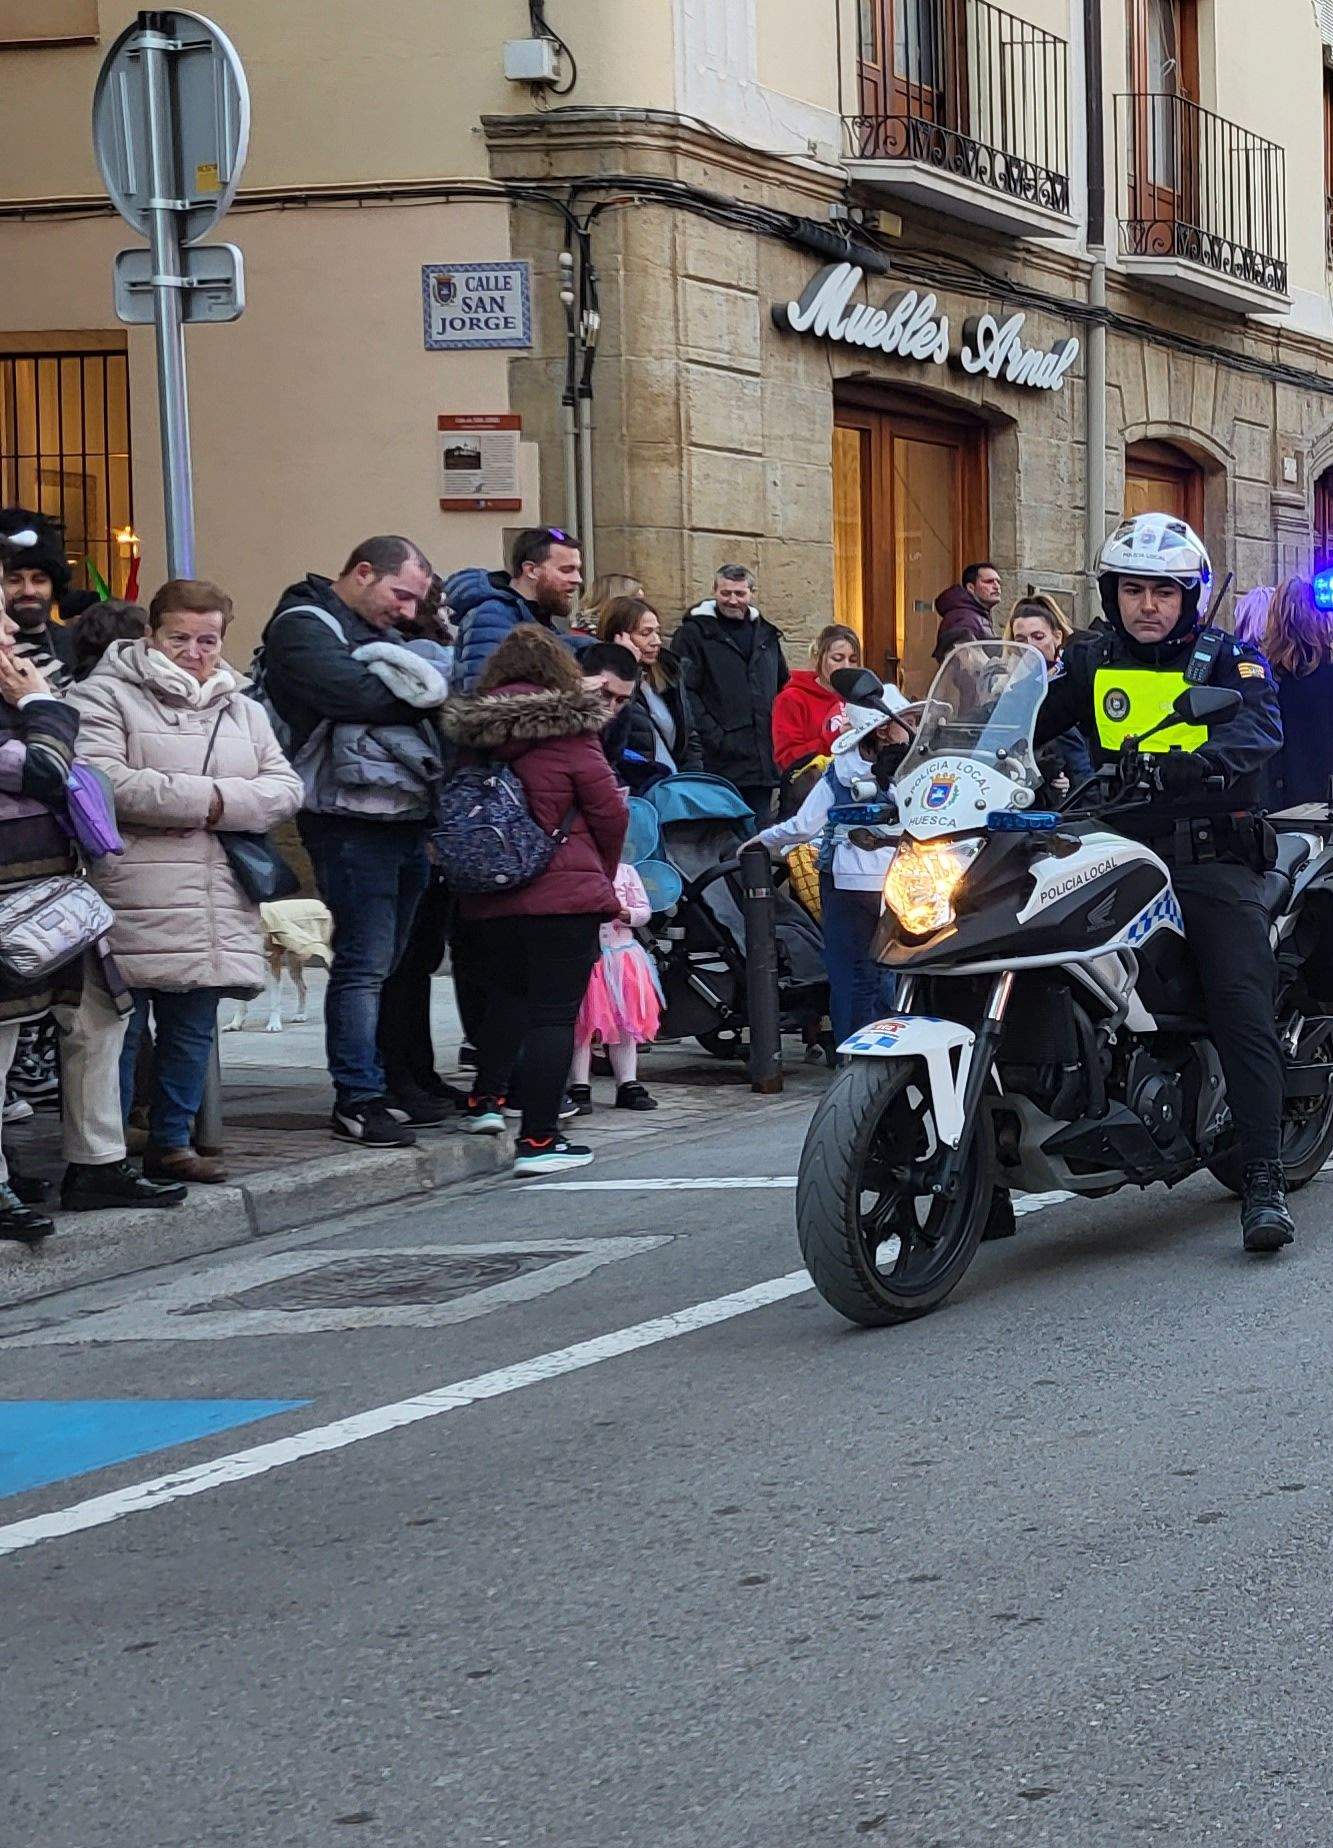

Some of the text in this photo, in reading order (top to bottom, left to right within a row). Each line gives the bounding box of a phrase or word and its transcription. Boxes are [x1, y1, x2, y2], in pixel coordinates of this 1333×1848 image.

[465, 275, 512, 292] CALLE
[461, 295, 506, 314] SAN
[436, 316, 517, 336] JORGE
[786, 262, 1079, 391] Muebles Arnal
[910, 760, 991, 796] POLICIA LOCAL
[909, 815, 957, 828] HUESCA
[1040, 856, 1118, 904] POLICIA LOCAL
